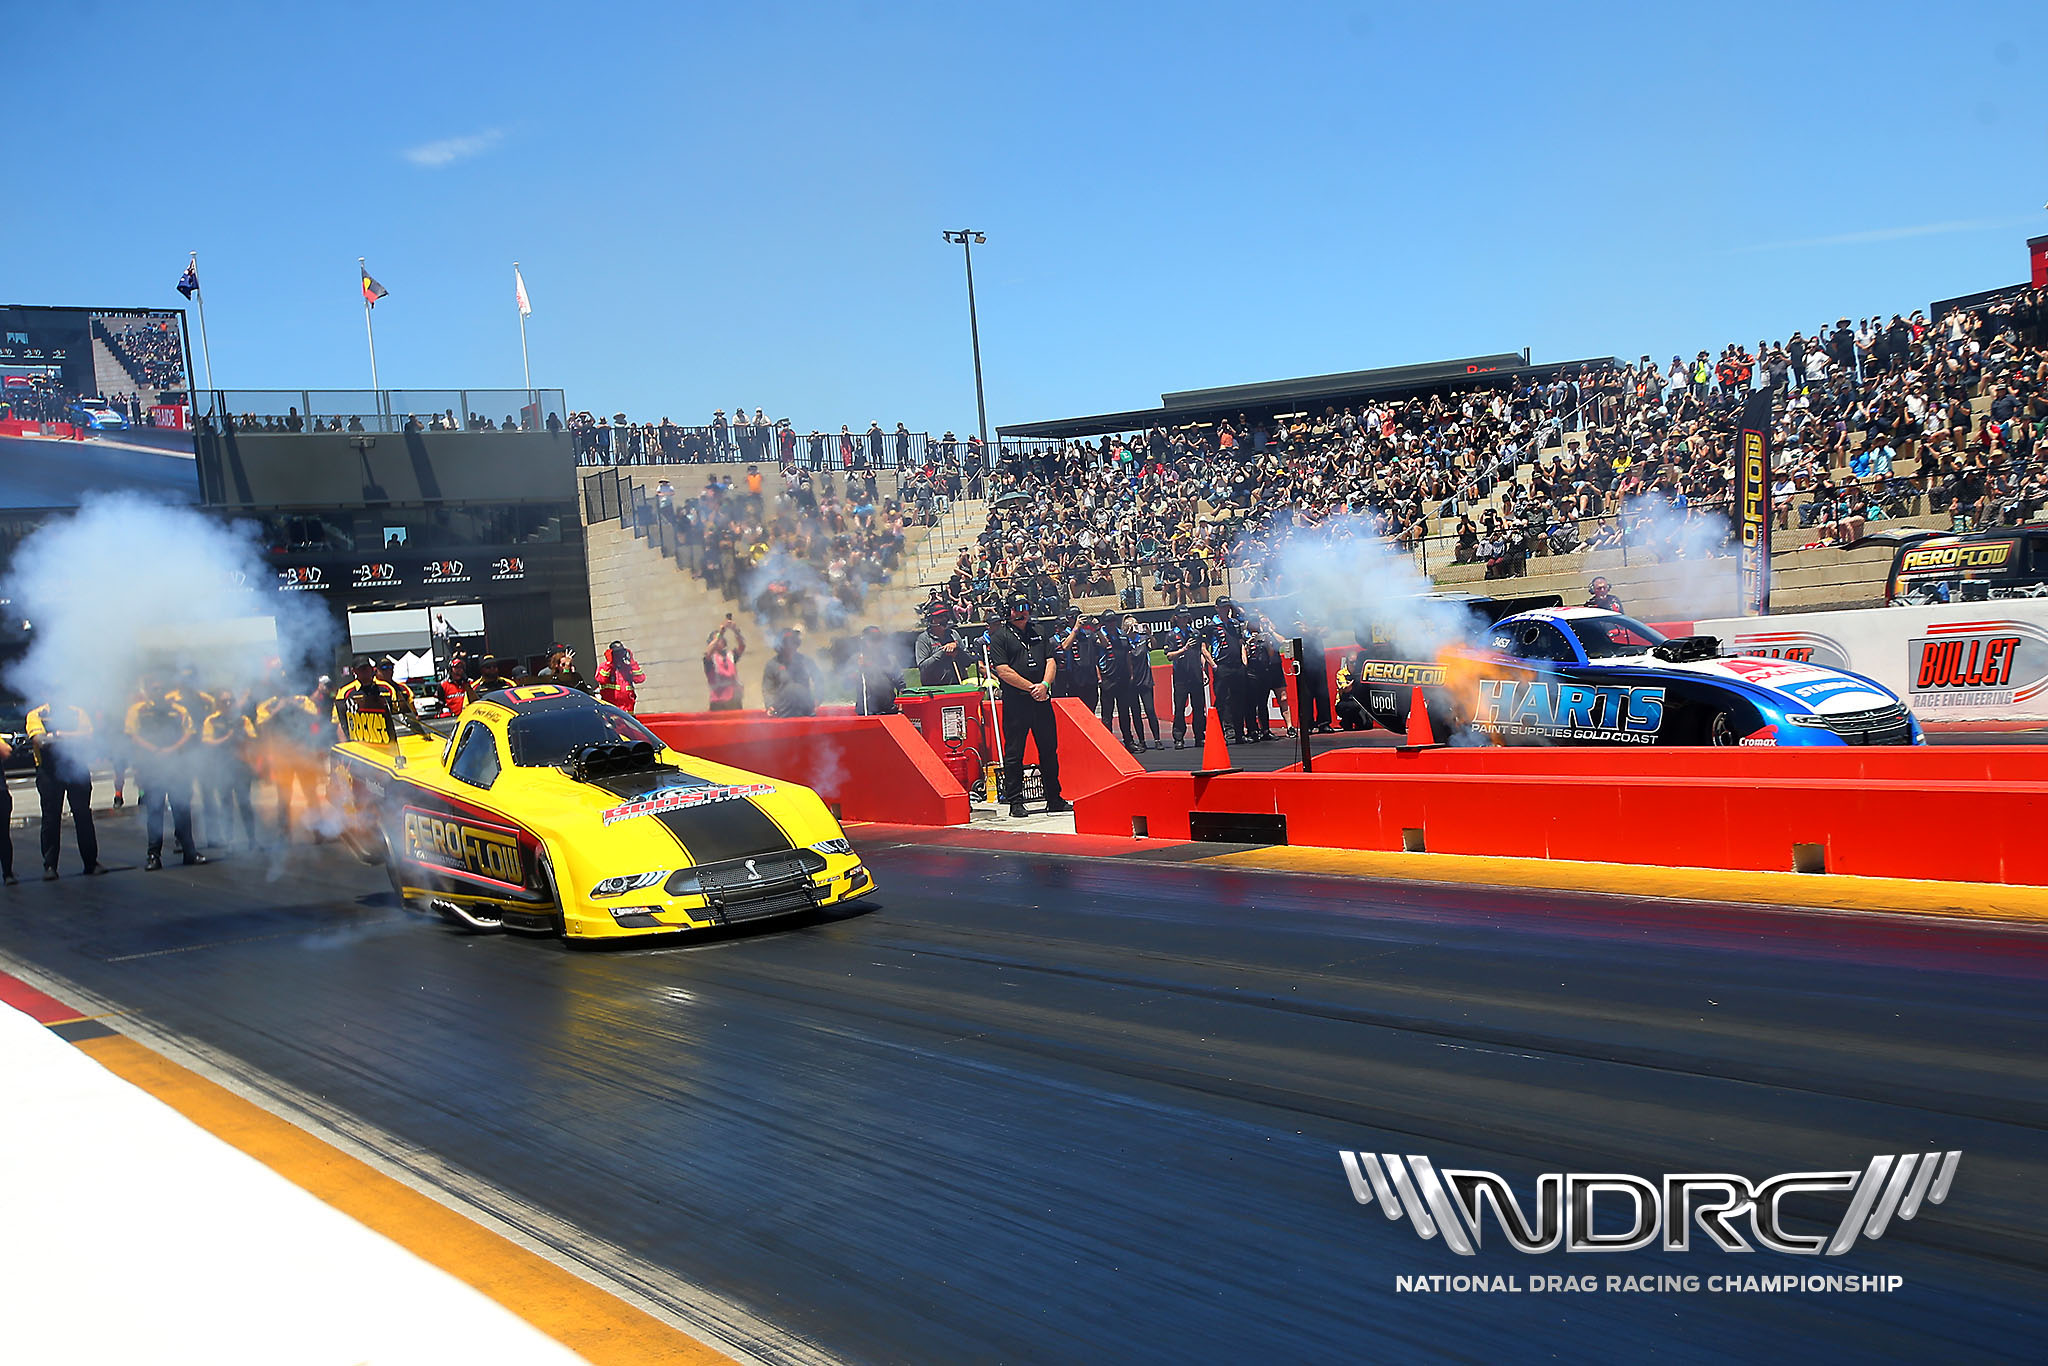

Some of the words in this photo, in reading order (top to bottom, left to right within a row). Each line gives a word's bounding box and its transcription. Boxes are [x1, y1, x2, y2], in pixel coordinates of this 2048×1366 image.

[1743, 433, 1764, 616] AEROFLOW
[432, 560, 463, 578] BEND
[1903, 544, 2010, 571] AEROFLOW
[287, 566, 322, 585] BEND
[360, 563, 394, 581] BEND
[1362, 662, 1448, 685] AEROFLOW
[1917, 637, 2021, 688] BULLET
[1472, 680, 1667, 733] HARTS
[1913, 694, 1940, 708] RACE
[1942, 691, 2012, 707] ENGINEERING
[1471, 724, 1508, 735] PAINT
[1510, 727, 1572, 738] SUPPLIES
[1738, 737, 1777, 747] Cromax
[603, 784, 775, 819] BOOSTED
[404, 813, 523, 883] AEROFLOW
